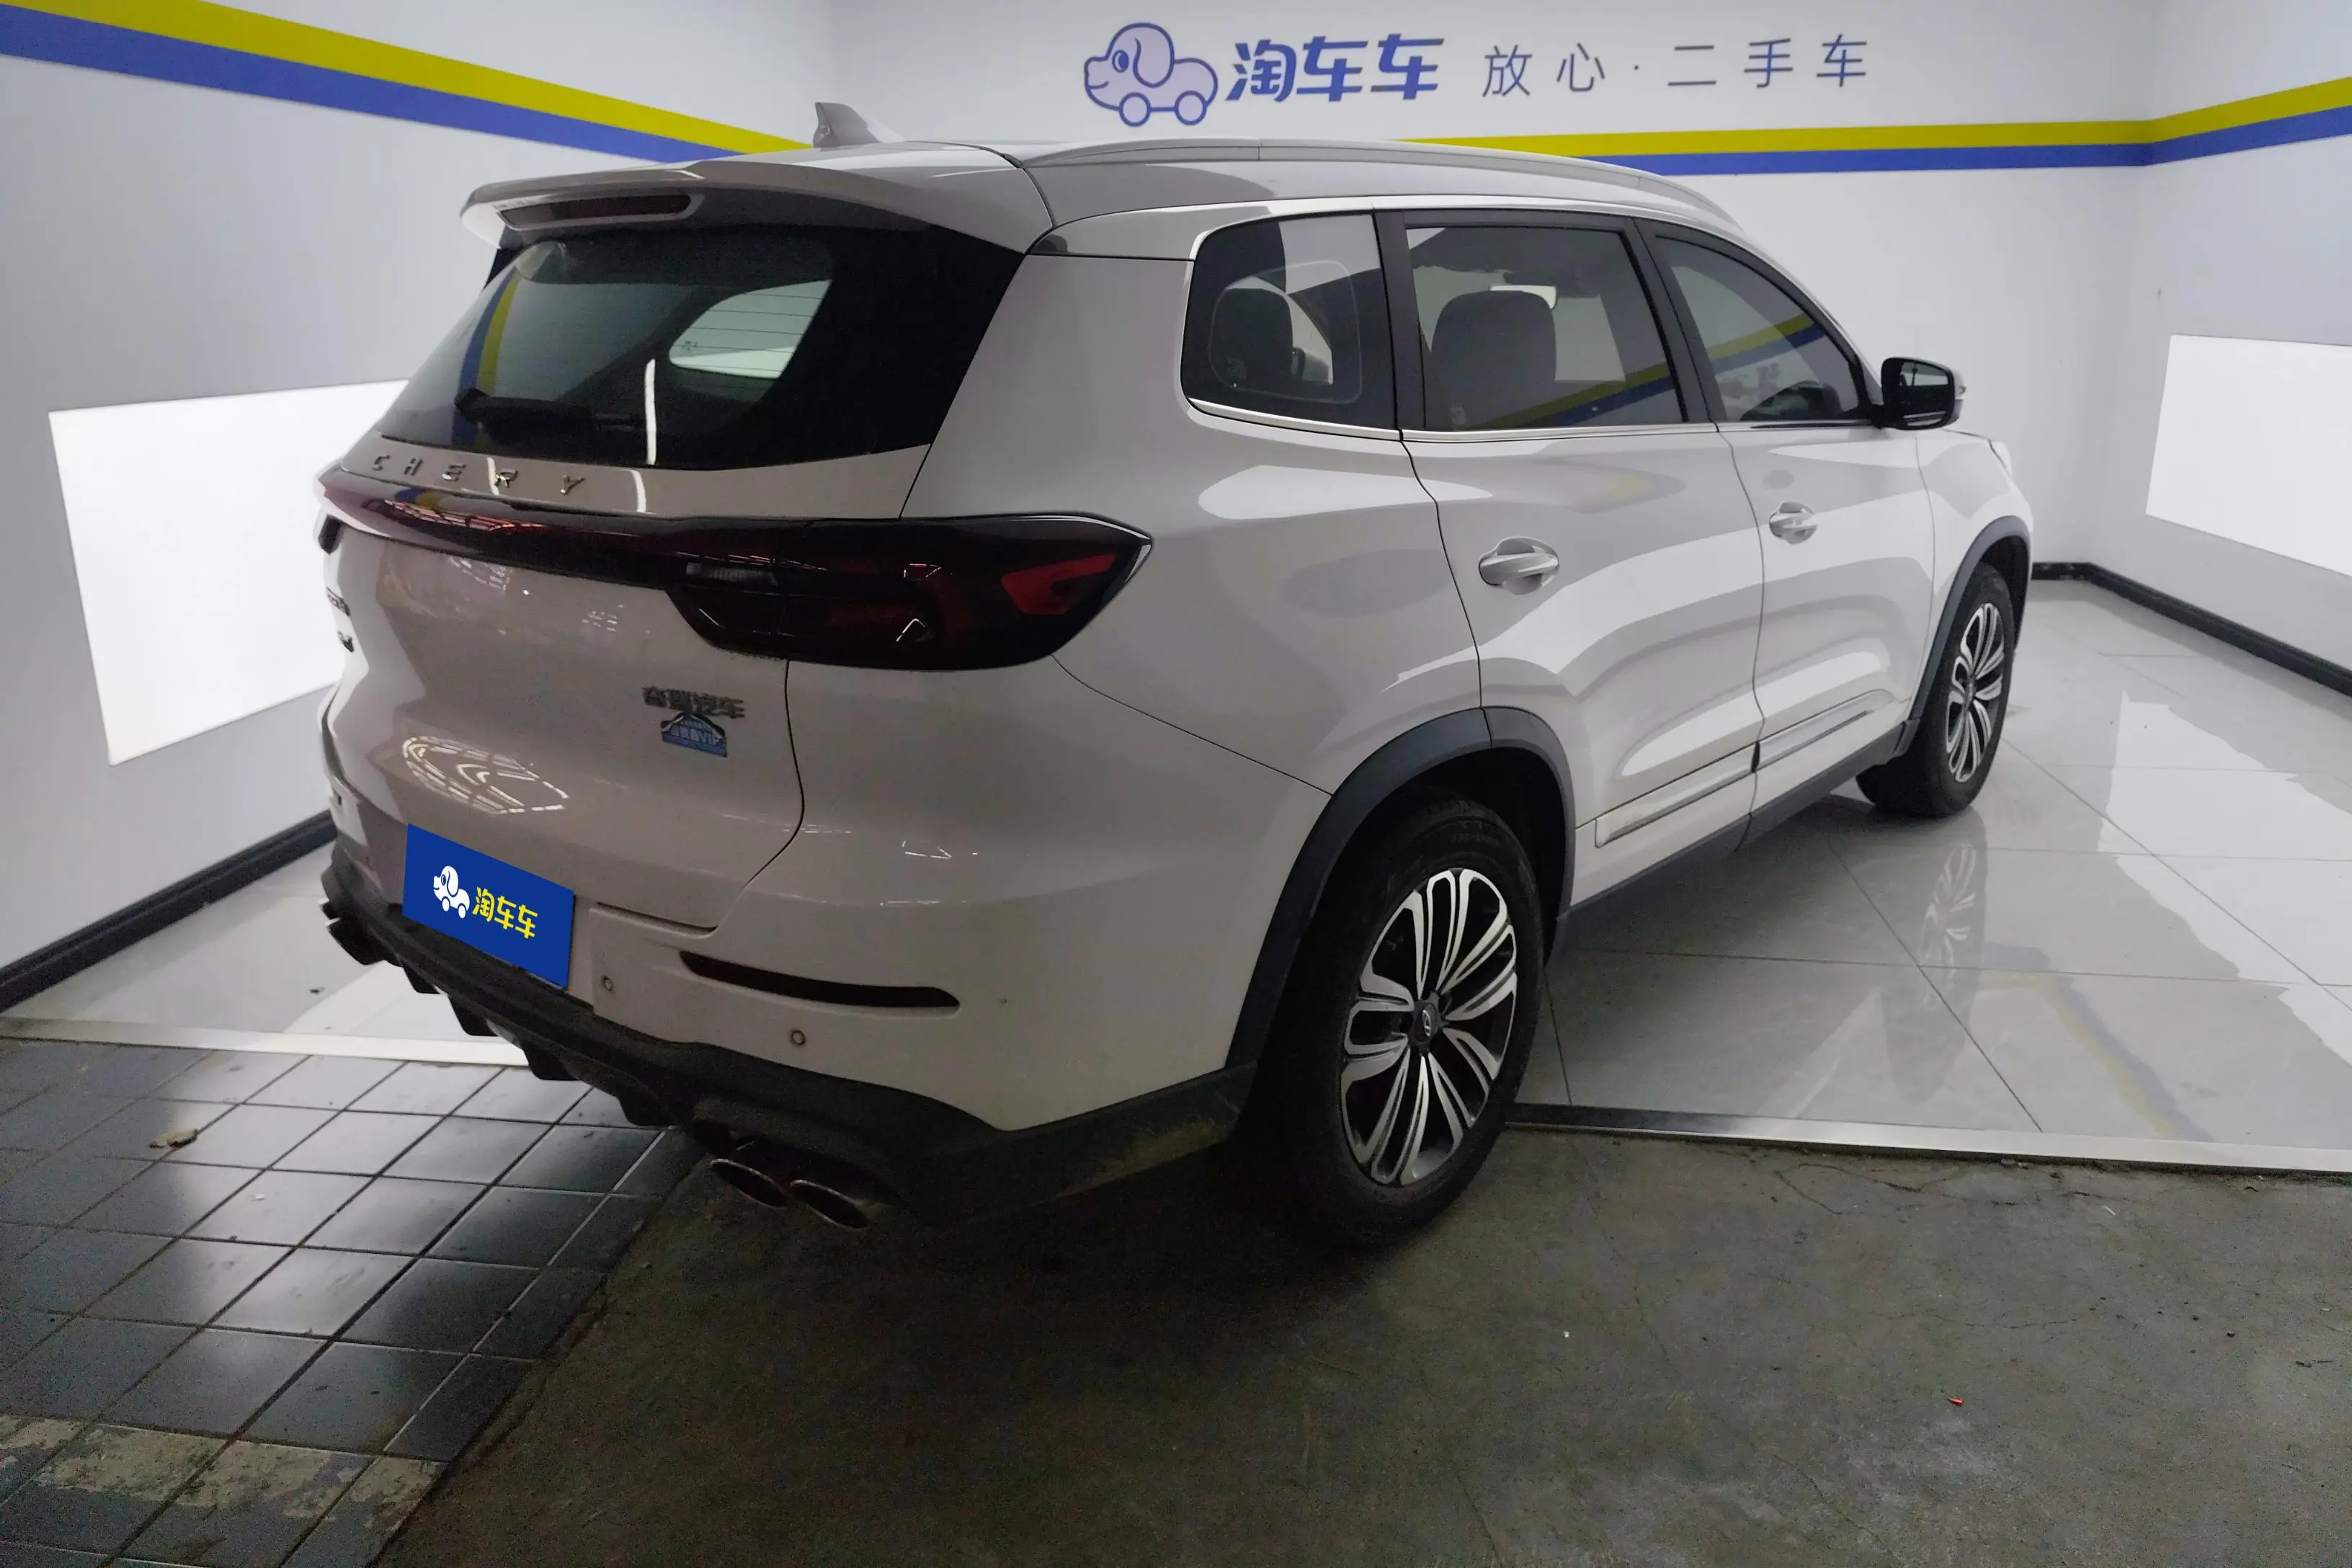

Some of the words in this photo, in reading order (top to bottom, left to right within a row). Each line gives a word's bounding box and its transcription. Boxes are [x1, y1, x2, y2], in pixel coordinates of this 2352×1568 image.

[1226, 33, 1445, 102] 淘车车
[370, 453, 586, 496] CHERY
